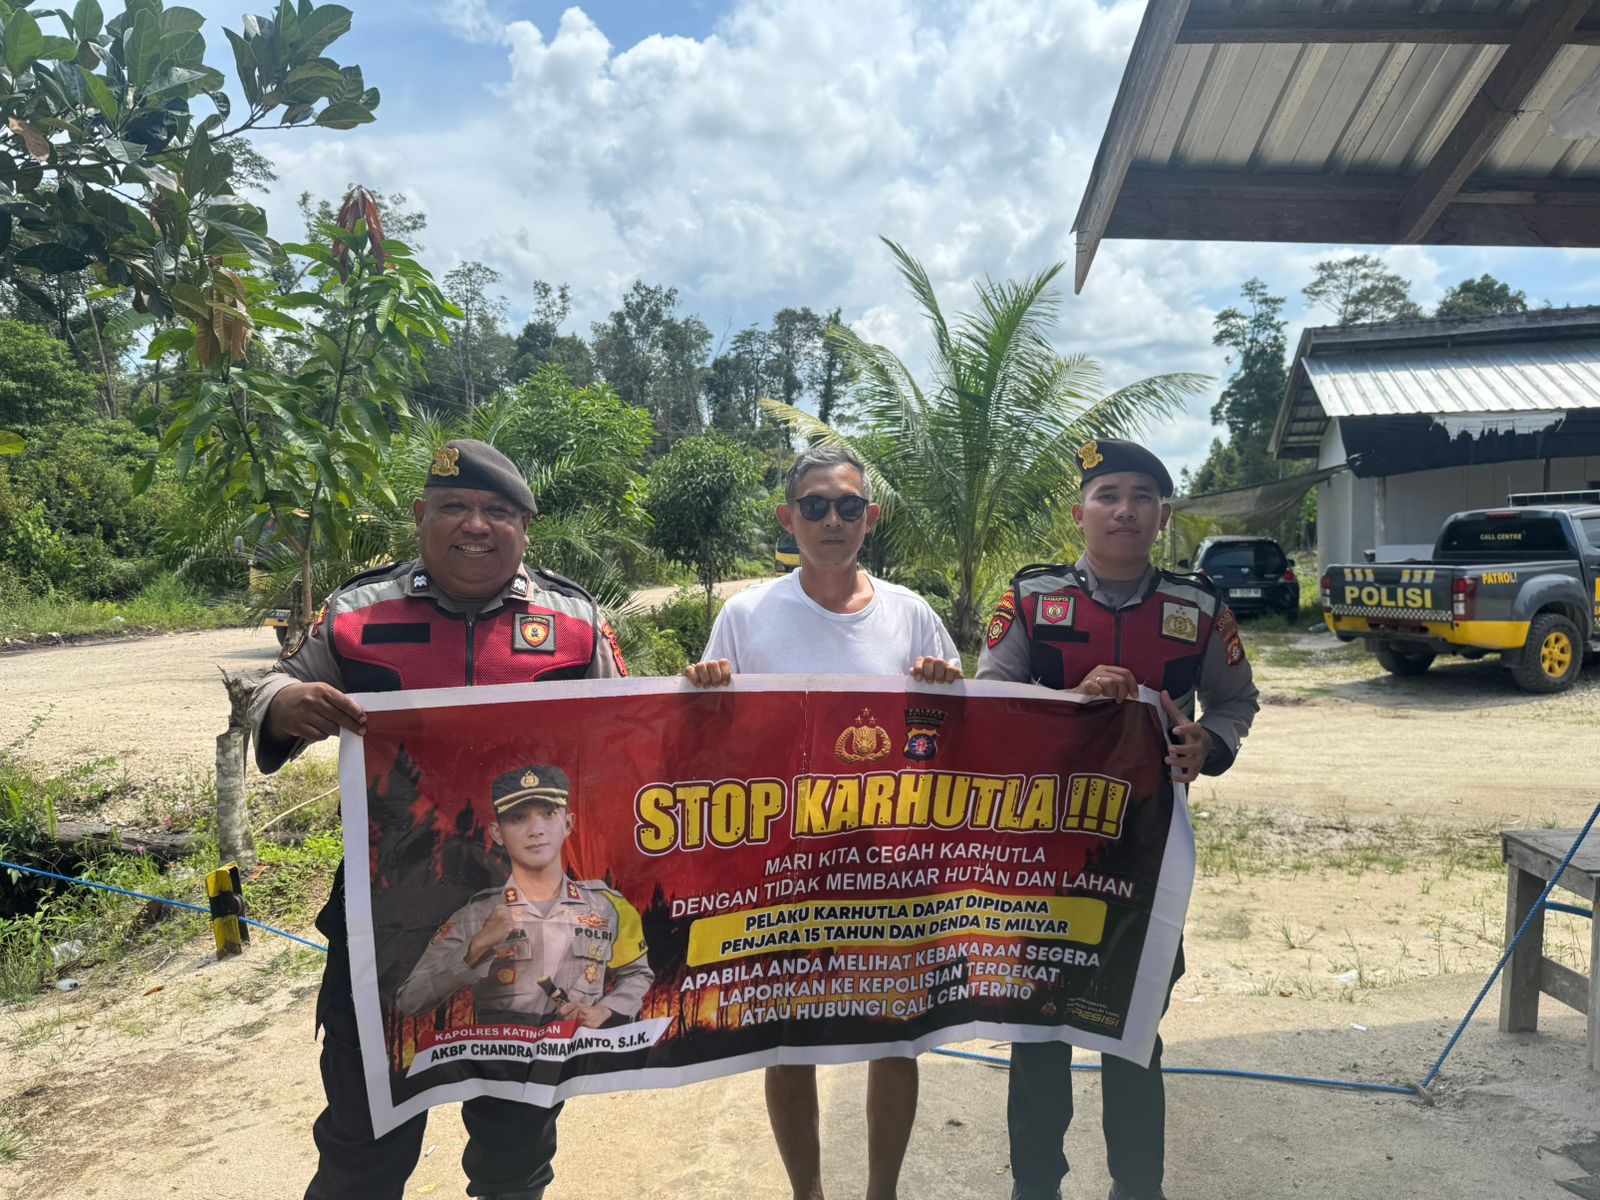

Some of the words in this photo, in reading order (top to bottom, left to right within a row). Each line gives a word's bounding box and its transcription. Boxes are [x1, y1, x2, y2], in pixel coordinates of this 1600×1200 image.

[1344, 586, 1432, 608] POLISI
[636, 779, 786, 855] STOP
[791, 770, 1057, 838] KARHUTLA
[1062, 774, 1130, 838] !!!
[764, 853, 812, 876] MARI
[818, 847, 860, 868] KITA
[866, 843, 934, 864] CEGAH
[940, 843, 1046, 863] KARHUTLA
[671, 886, 758, 917] DENGAN
[764, 875, 819, 897] TIDAK
[826, 868, 940, 890] MEMBAKAR
[945, 865, 1011, 886] HUTAN
[1015, 871, 1056, 887] DAN
[1062, 872, 1133, 897] LAHAN
[745, 906, 810, 931] PELAKU
[814, 904, 909, 921] KARHUTLA
[913, 897, 963, 918] DAPAT
[966, 895, 1049, 914] DIPIDANA
[574, 927, 612, 941] POLRI
[720, 929, 800, 955] PENJARA
[804, 927, 820, 942] 15
[824, 924, 884, 941] TAHUN
[889, 924, 925, 940] DAN
[929, 915, 980, 935] DENDA
[985, 916, 1000, 930] 15
[1004, 918, 1068, 934] MILYAR
[680, 962, 762, 992] APABILA
[767, 957, 823, 976] ANDA
[828, 953, 912, 972] MELIHAT
[915, 941, 1021, 966] KEBAKARAN
[1026, 946, 1100, 967] SEGERA
[719, 979, 825, 1007] LAPORKAN
[831, 977, 854, 994] KE
[858, 963, 962, 993] KEPOLISIAN
[966, 961, 1060, 983] TERDEKAT
[741, 1003, 791, 1026] ATAU
[796, 999, 886, 1020] HUBUNGI
[891, 994, 934, 1016] CALL
[937, 981, 1000, 1004] CENTER
[1005, 983, 1032, 1000] 110
[430, 1043, 467, 1062] AKBP
[471, 1042, 533, 1059] CHANDRA
[536, 1037, 614, 1057] ISMAWANTO,
[617, 1031, 650, 1049] S.I.K.
[435, 1027, 499, 1041] KAPOLRES
[503, 1025, 561, 1039] KATINGAN
